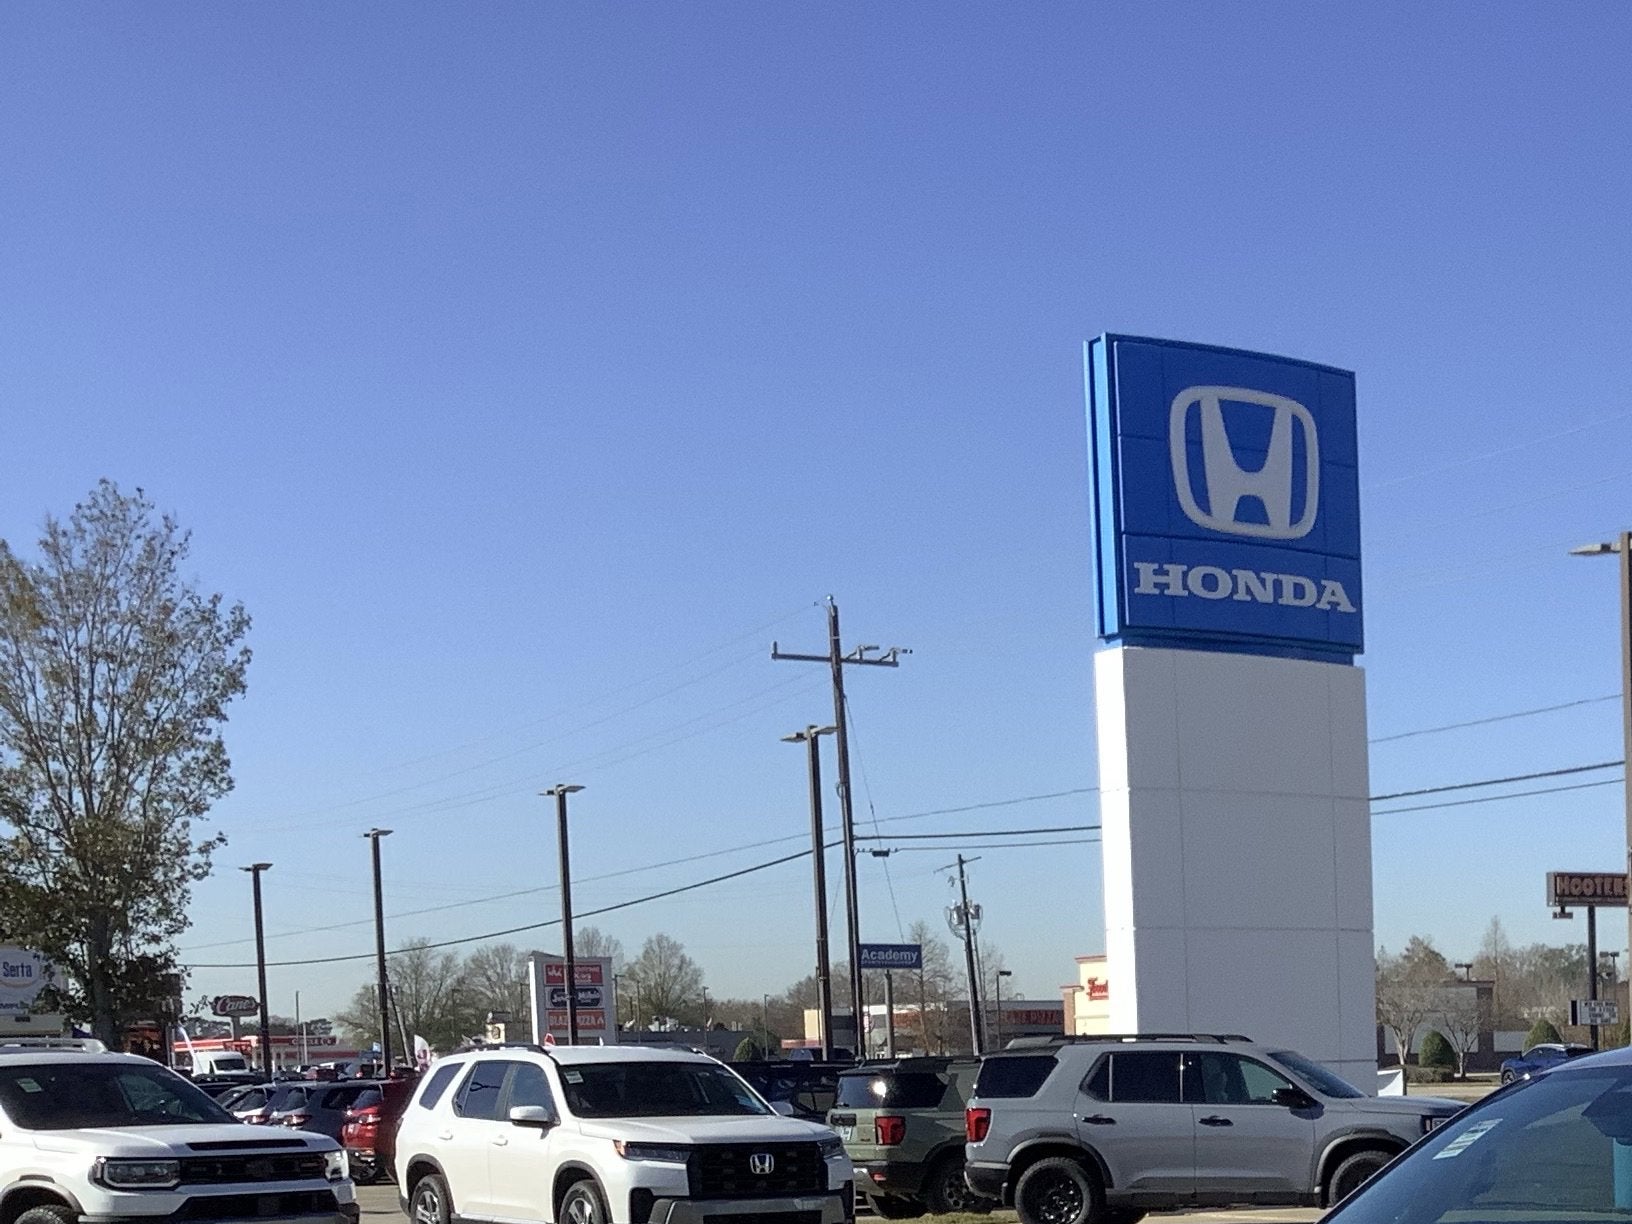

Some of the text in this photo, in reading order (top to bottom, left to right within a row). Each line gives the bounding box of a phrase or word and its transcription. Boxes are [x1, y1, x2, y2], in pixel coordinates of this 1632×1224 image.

[1133, 562, 1357, 612] HONDA
[861, 949, 919, 964] Academy
[2, 961, 33, 978] Serta
